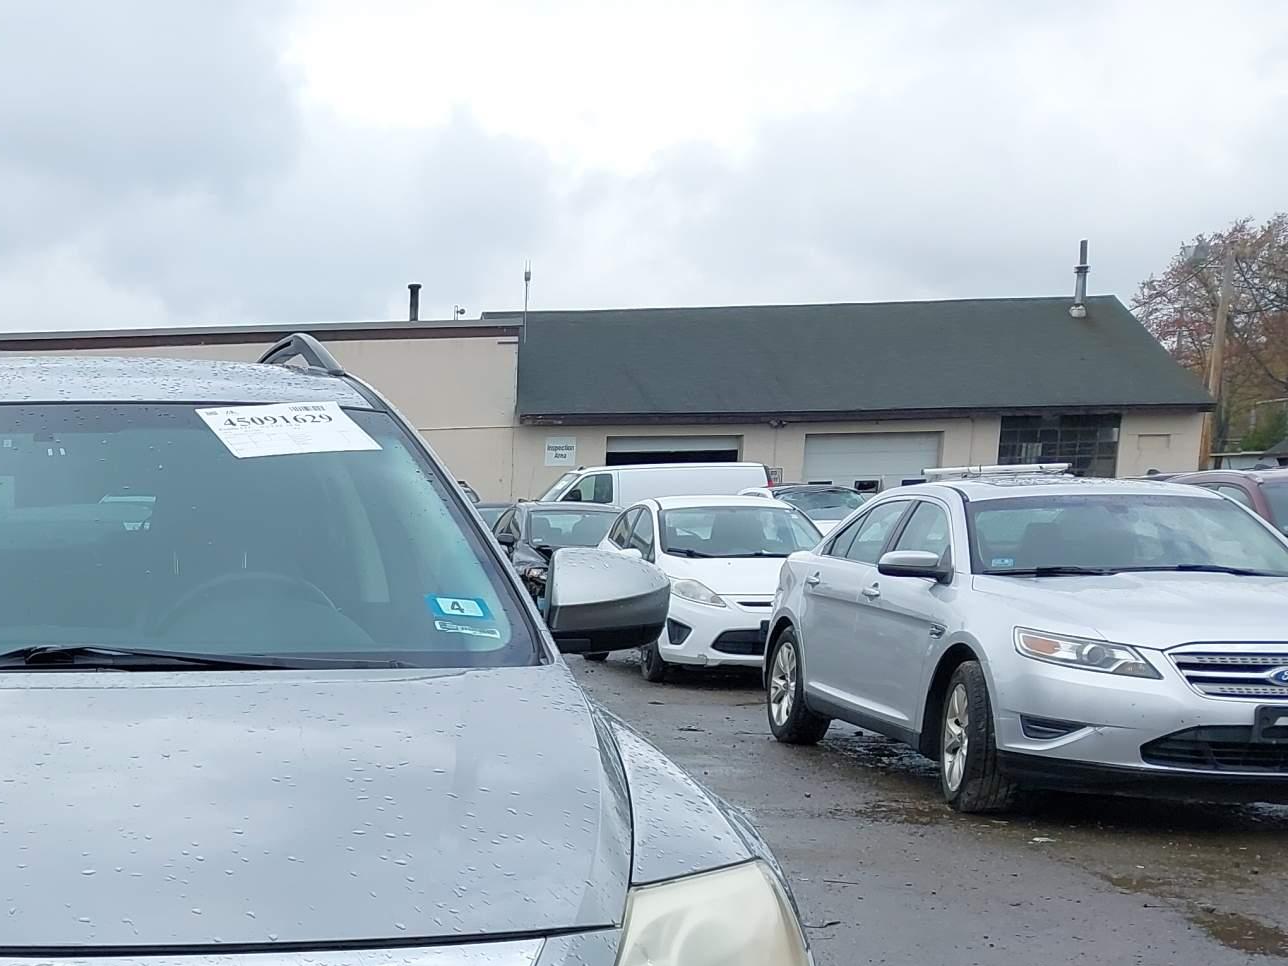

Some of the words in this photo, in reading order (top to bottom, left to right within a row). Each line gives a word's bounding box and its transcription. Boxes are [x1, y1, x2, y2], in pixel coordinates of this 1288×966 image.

[223, 414, 333, 427] 45091629
[546, 444, 575, 452] Inspection
[450, 601, 465, 614] 4
